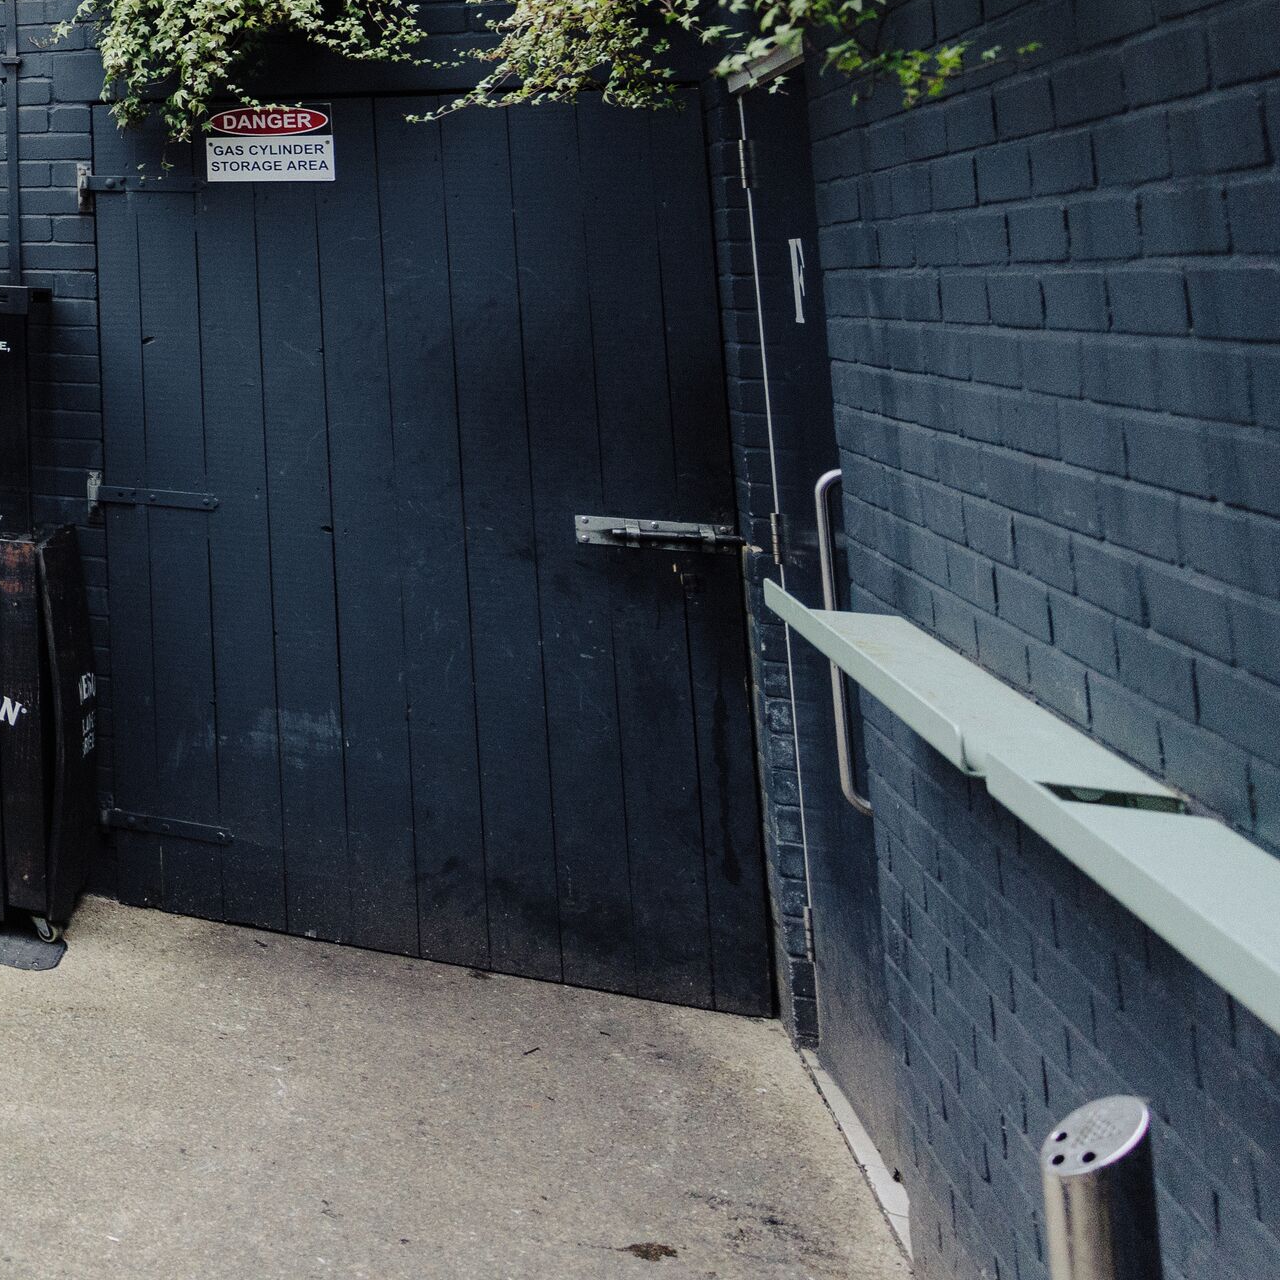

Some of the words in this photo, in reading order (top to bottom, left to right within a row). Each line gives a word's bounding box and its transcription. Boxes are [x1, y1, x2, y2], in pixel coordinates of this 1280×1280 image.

[222, 113, 312, 130] DANGER
[213, 145, 244, 156] GAS
[249, 144, 325, 156] CYLINDER
[211, 160, 282, 172] STORAGE
[287, 160, 329, 171] AREA
